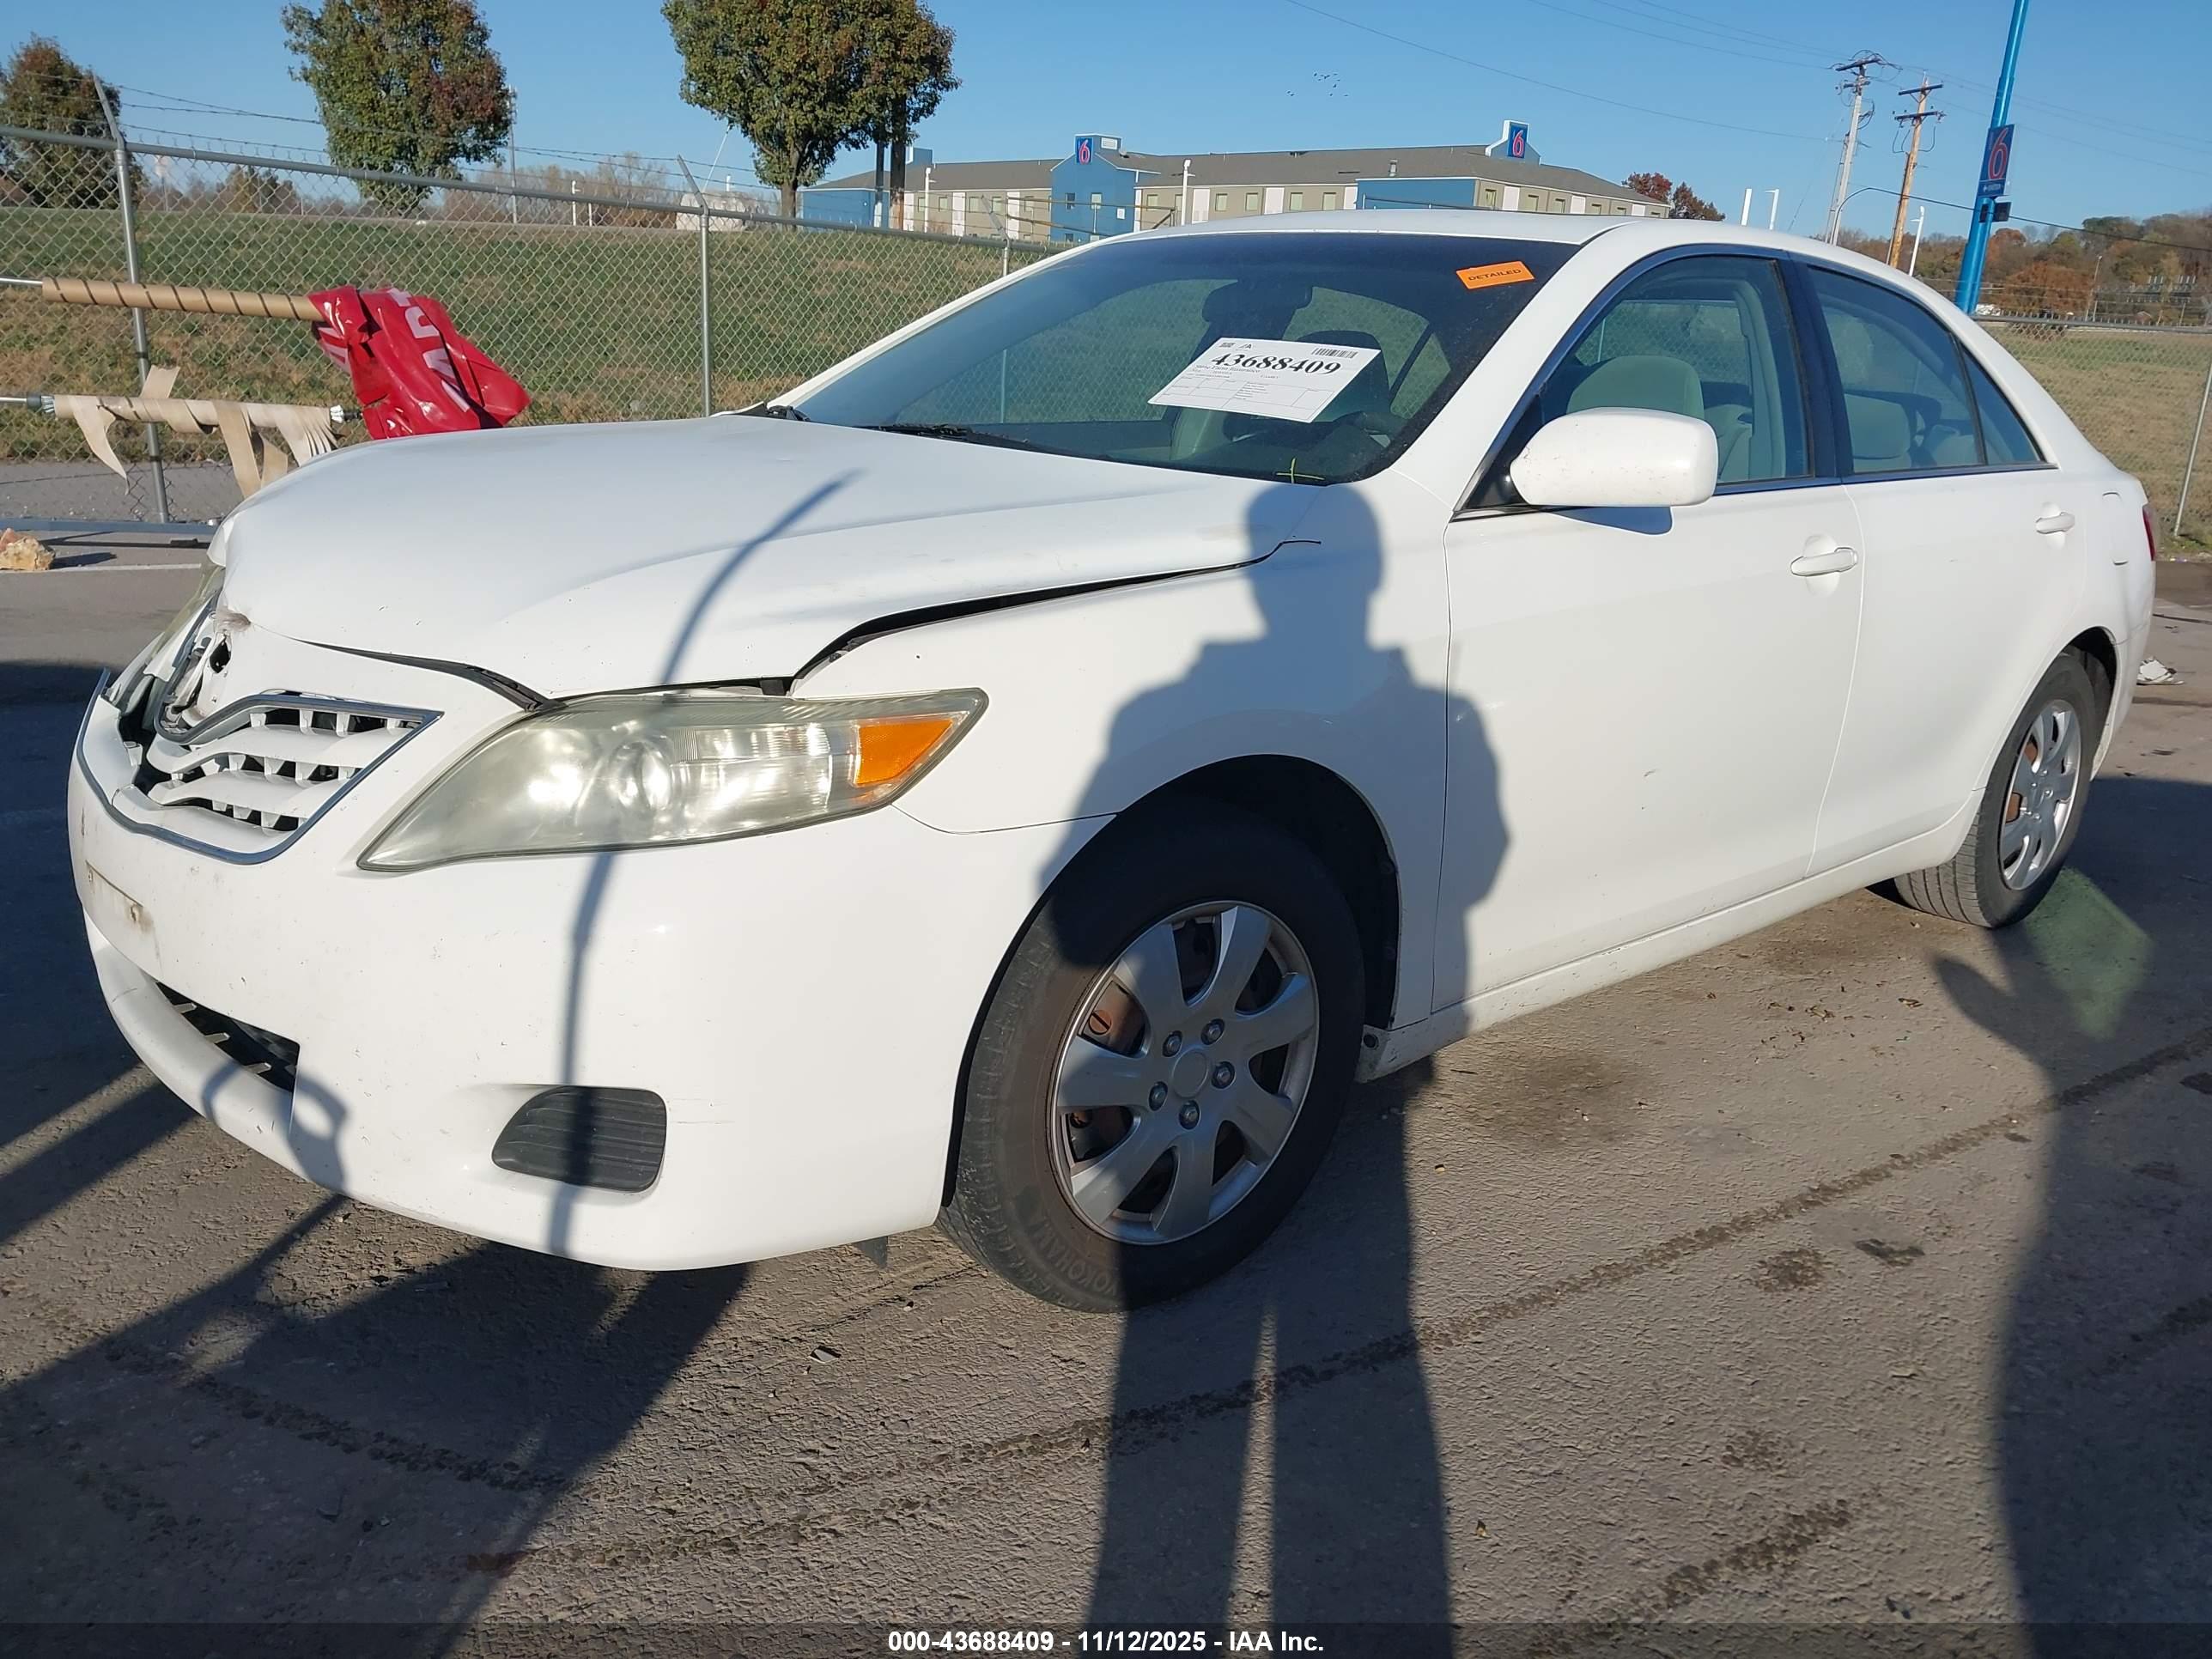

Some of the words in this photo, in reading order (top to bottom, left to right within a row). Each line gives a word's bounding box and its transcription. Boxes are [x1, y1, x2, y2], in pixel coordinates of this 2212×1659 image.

[1079, 139, 1091, 165] 6
[1513, 130, 1524, 156] 6
[1988, 128, 2008, 179] 6
[1468, 269, 1522, 280] DETAILED
[1212, 352, 1341, 375] 43688409
